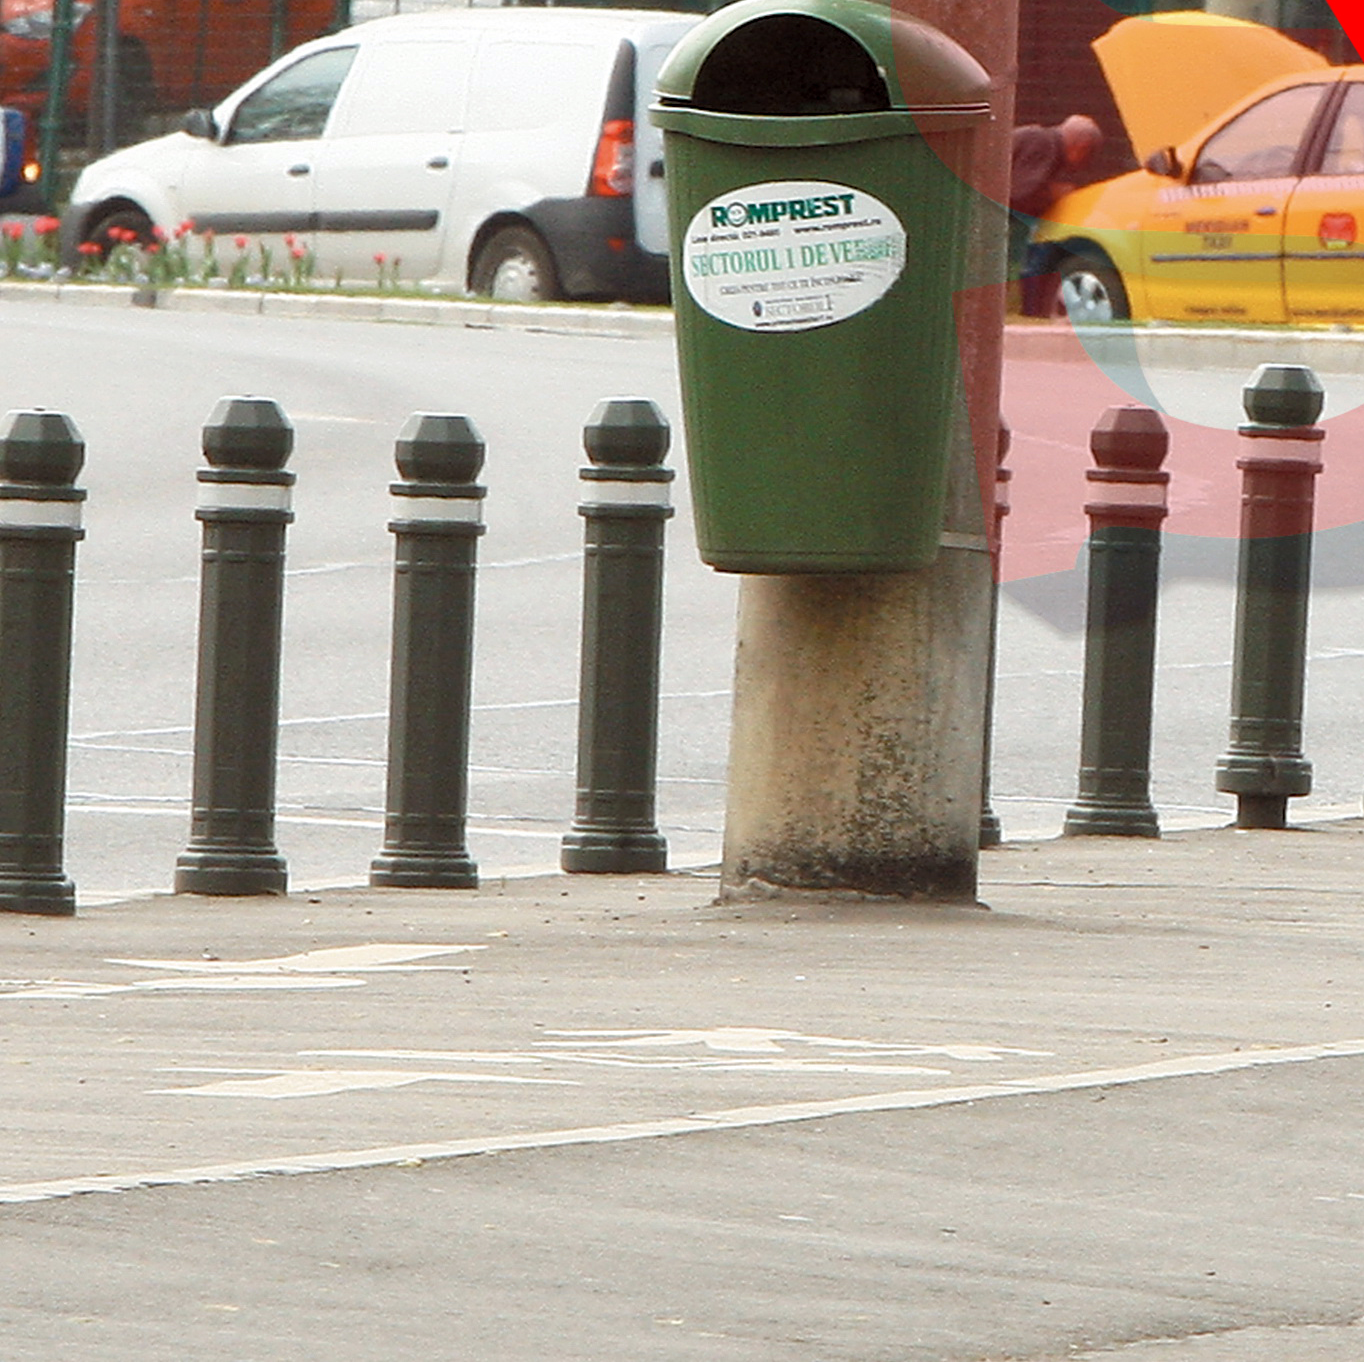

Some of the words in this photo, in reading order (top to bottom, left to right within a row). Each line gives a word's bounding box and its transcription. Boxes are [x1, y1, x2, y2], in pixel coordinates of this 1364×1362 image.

[711, 194, 855, 228] ROMPREST
[692, 249, 782, 277] SECTORUL
[801, 245, 826, 268] DE
